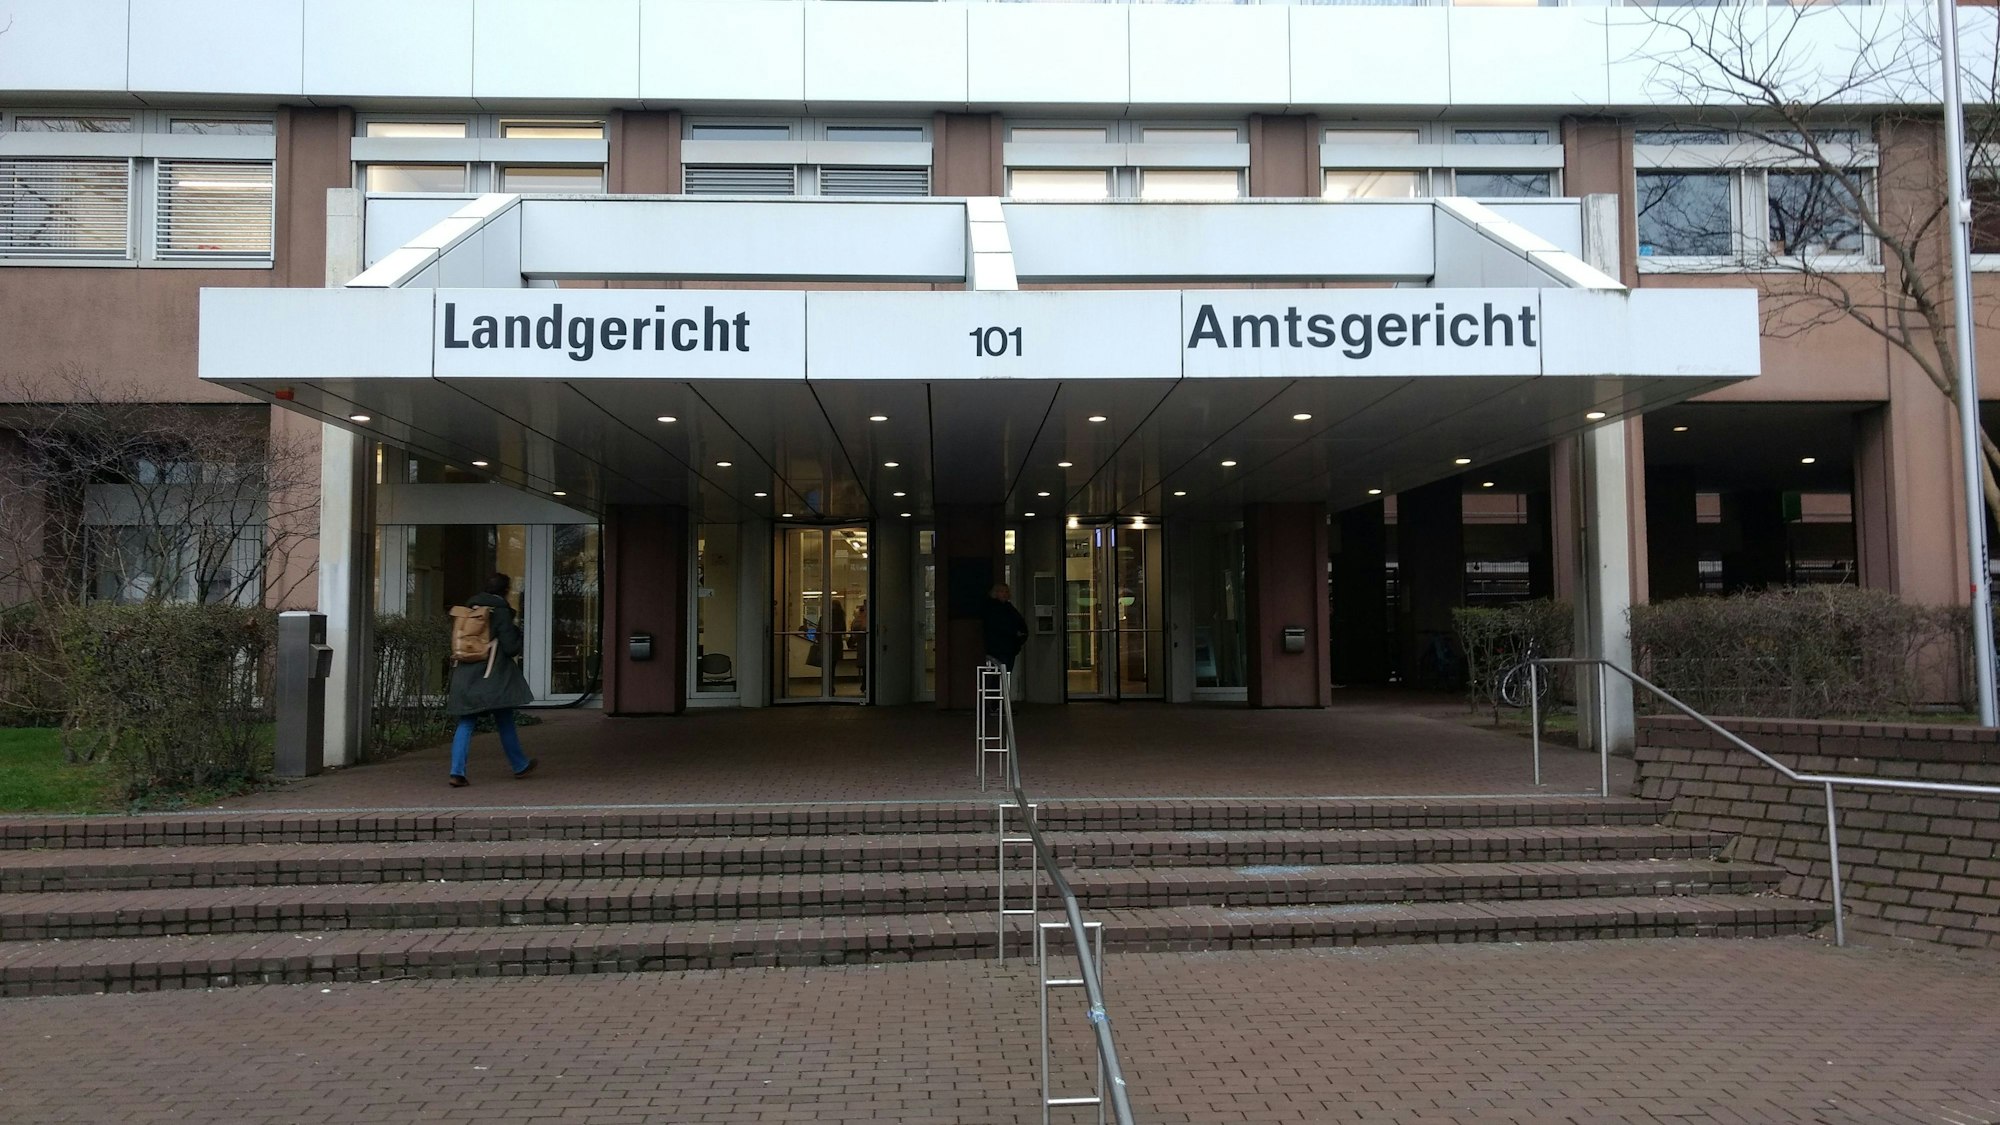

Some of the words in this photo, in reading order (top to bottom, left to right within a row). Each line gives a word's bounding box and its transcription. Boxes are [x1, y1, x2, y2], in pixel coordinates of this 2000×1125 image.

[444, 302, 750, 362] Landgericht
[969, 327, 1022, 357] 101
[1188, 302, 1538, 360] Amtsgericht
